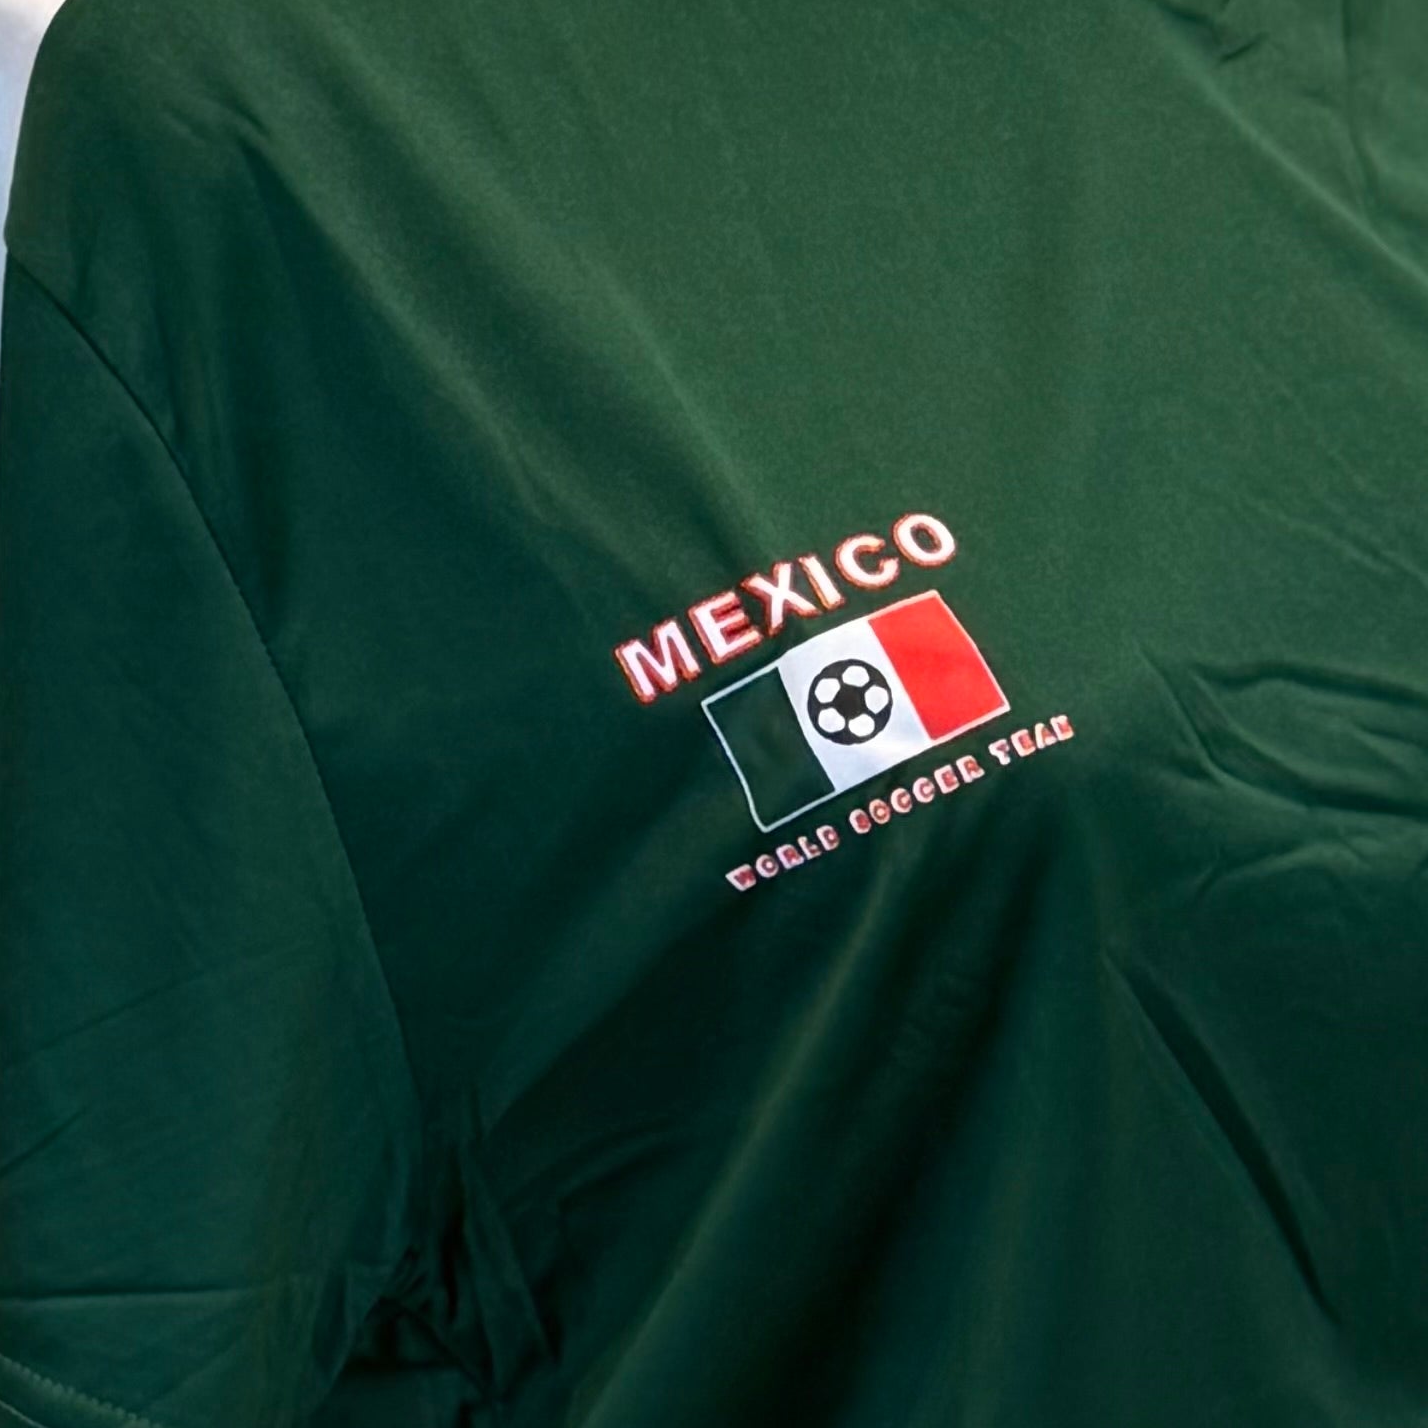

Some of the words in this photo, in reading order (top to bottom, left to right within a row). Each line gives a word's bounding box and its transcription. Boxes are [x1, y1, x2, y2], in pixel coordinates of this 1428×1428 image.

[613, 511, 957, 705] MEXICO
[725, 824, 841, 892] WORLD
[848, 754, 986, 835] SOCCER
[987, 714, 1075, 766] TEAM
